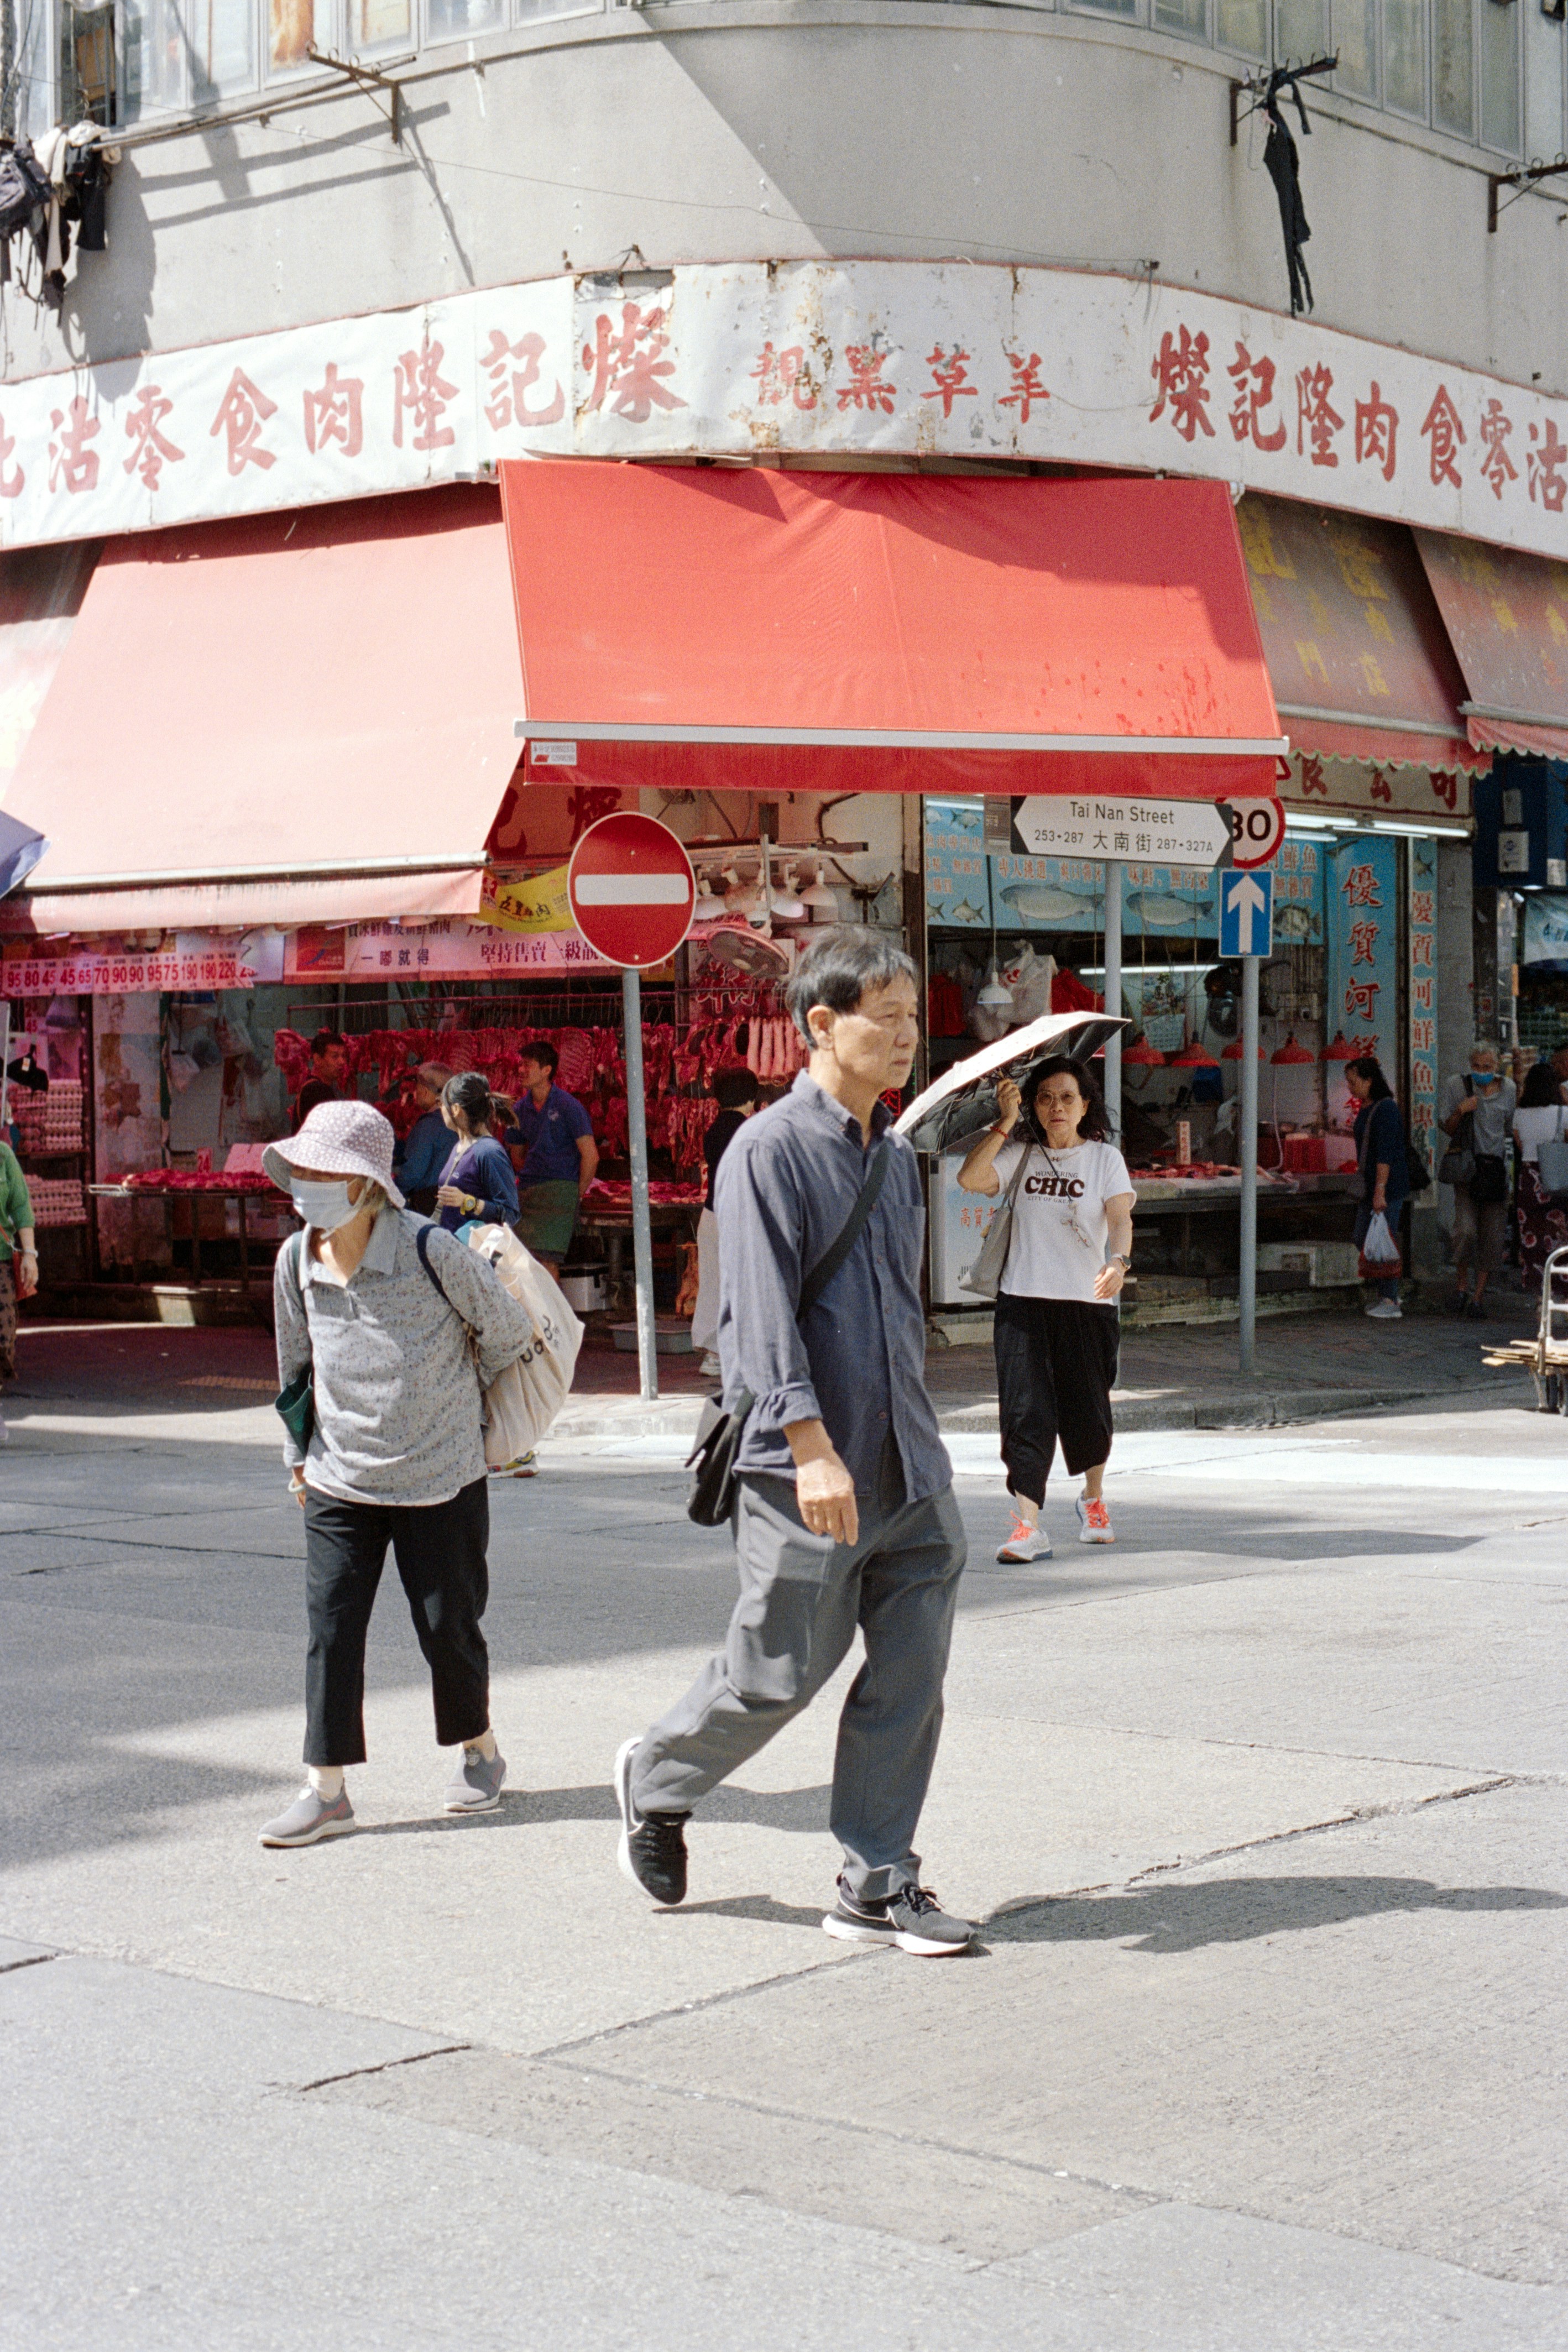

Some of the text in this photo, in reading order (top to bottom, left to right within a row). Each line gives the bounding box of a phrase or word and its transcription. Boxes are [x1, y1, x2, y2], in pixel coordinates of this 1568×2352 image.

[1070, 801, 1175, 824] Tai Nan Street
[1093, 830, 1152, 853] 大南街
[481, 941, 605, 963] 堅持售賣一級靚
[24, 970, 39, 987] 80
[60, 969, 75, 985] 45
[79, 969, 91, 984] 65
[95, 968, 109, 984] 70
[112, 966, 127, 983] 90
[129, 966, 144, 982] 90
[148, 965, 161, 981] 95
[164, 964, 179, 980] 75
[1025, 1175, 1085, 1198] CHIC
